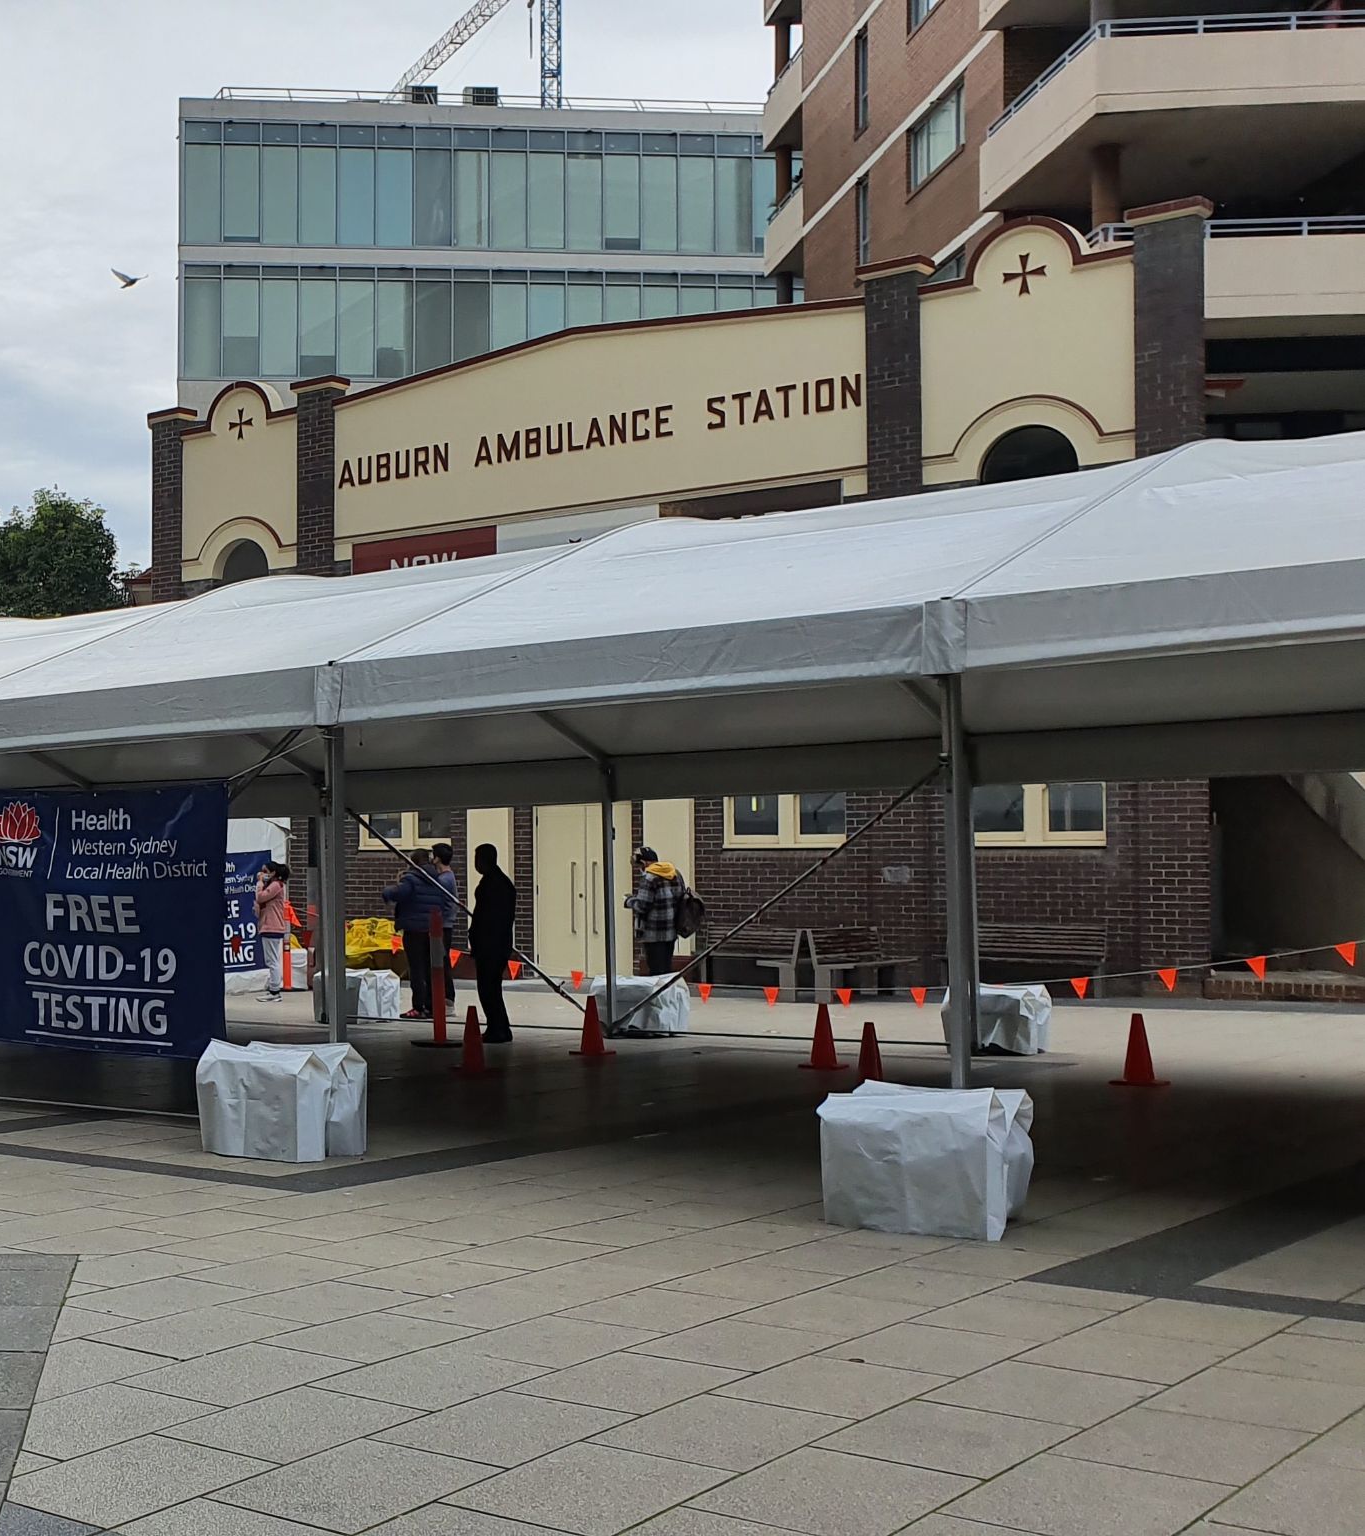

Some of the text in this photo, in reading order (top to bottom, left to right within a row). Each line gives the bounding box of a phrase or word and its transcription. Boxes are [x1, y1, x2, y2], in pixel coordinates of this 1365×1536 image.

[338, 373, 862, 489] AUBURN AMBULANCE STATION
[71, 808, 131, 831] Health
[71, 836, 178, 859] Western Sydney
[65, 859, 208, 879] Local Health District
[45, 893, 140, 934] FREE
[223, 922, 257, 941] D-19
[23, 941, 177, 983] COVID-19
[32, 991, 168, 1036] TESTING
